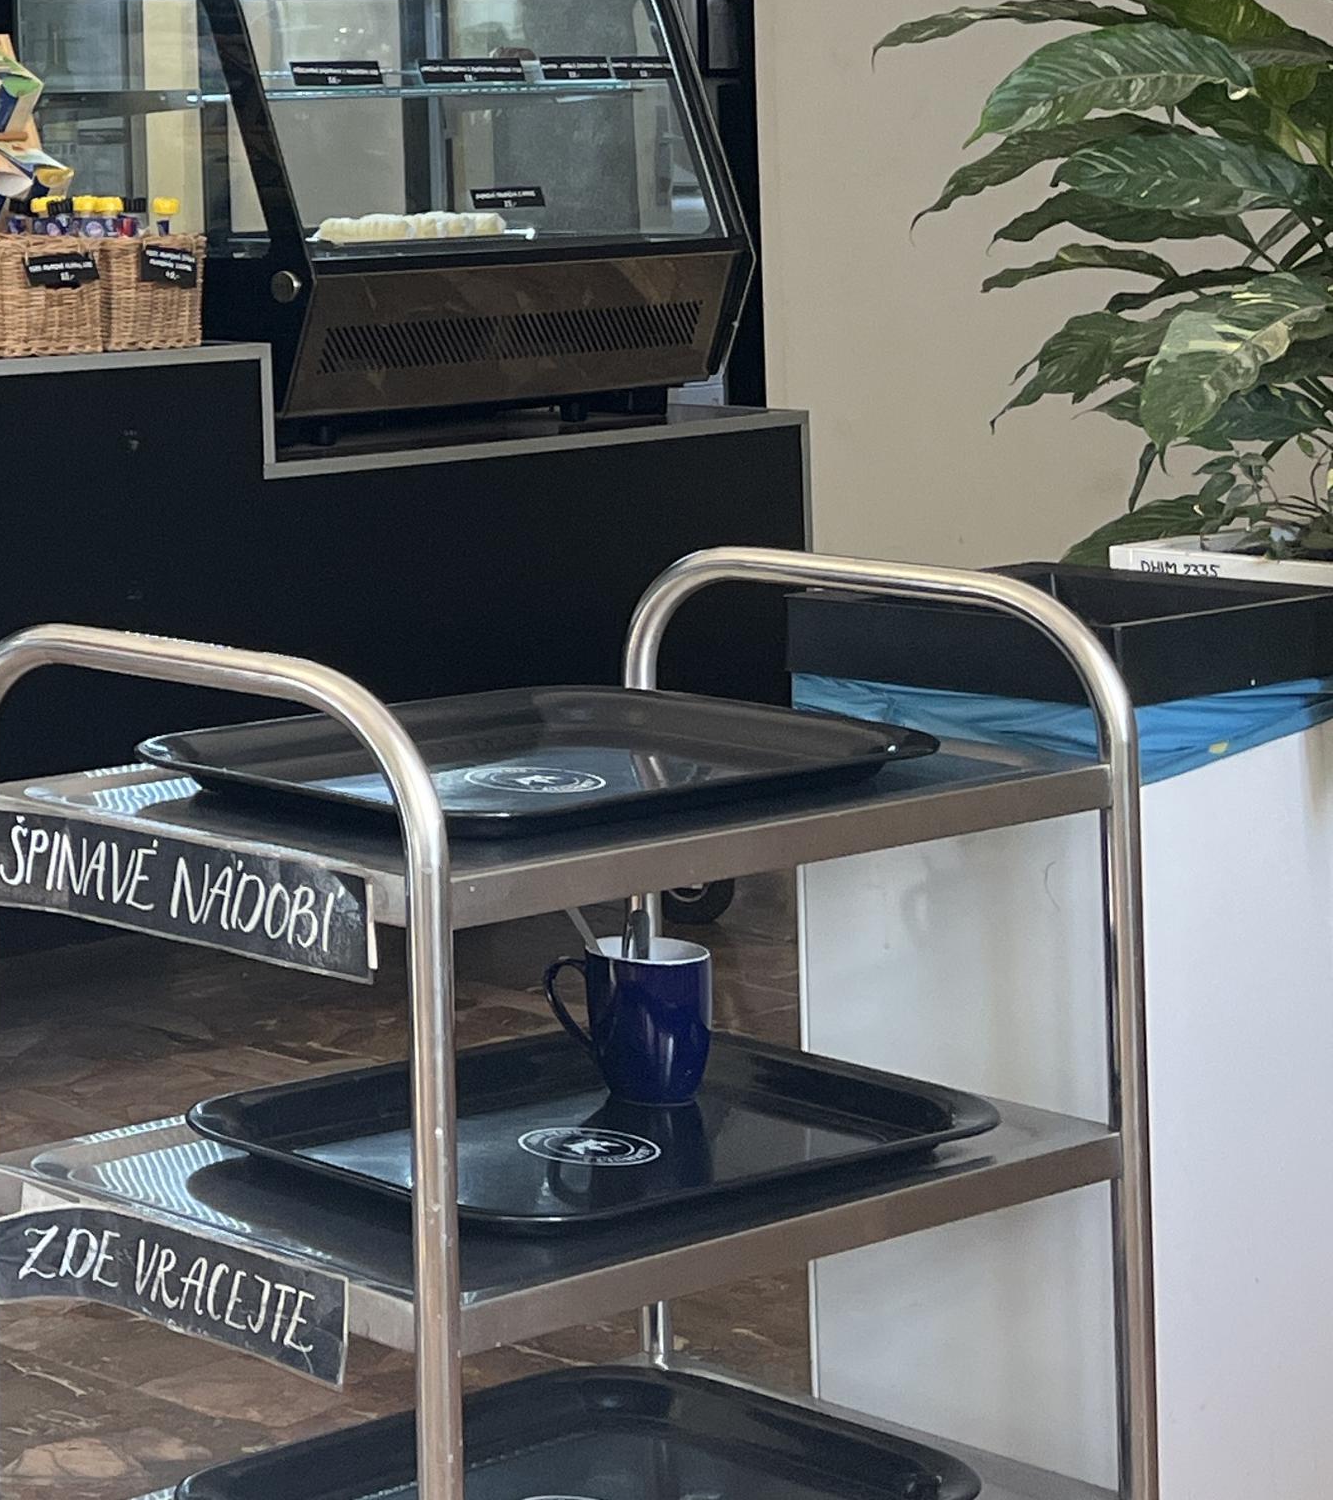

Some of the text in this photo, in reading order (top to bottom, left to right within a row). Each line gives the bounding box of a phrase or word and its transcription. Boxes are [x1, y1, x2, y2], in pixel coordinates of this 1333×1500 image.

[170, 856, 347, 953] NÁDOBÍ
[18, 1225, 316, 1354] ZDE VRACEJTE
